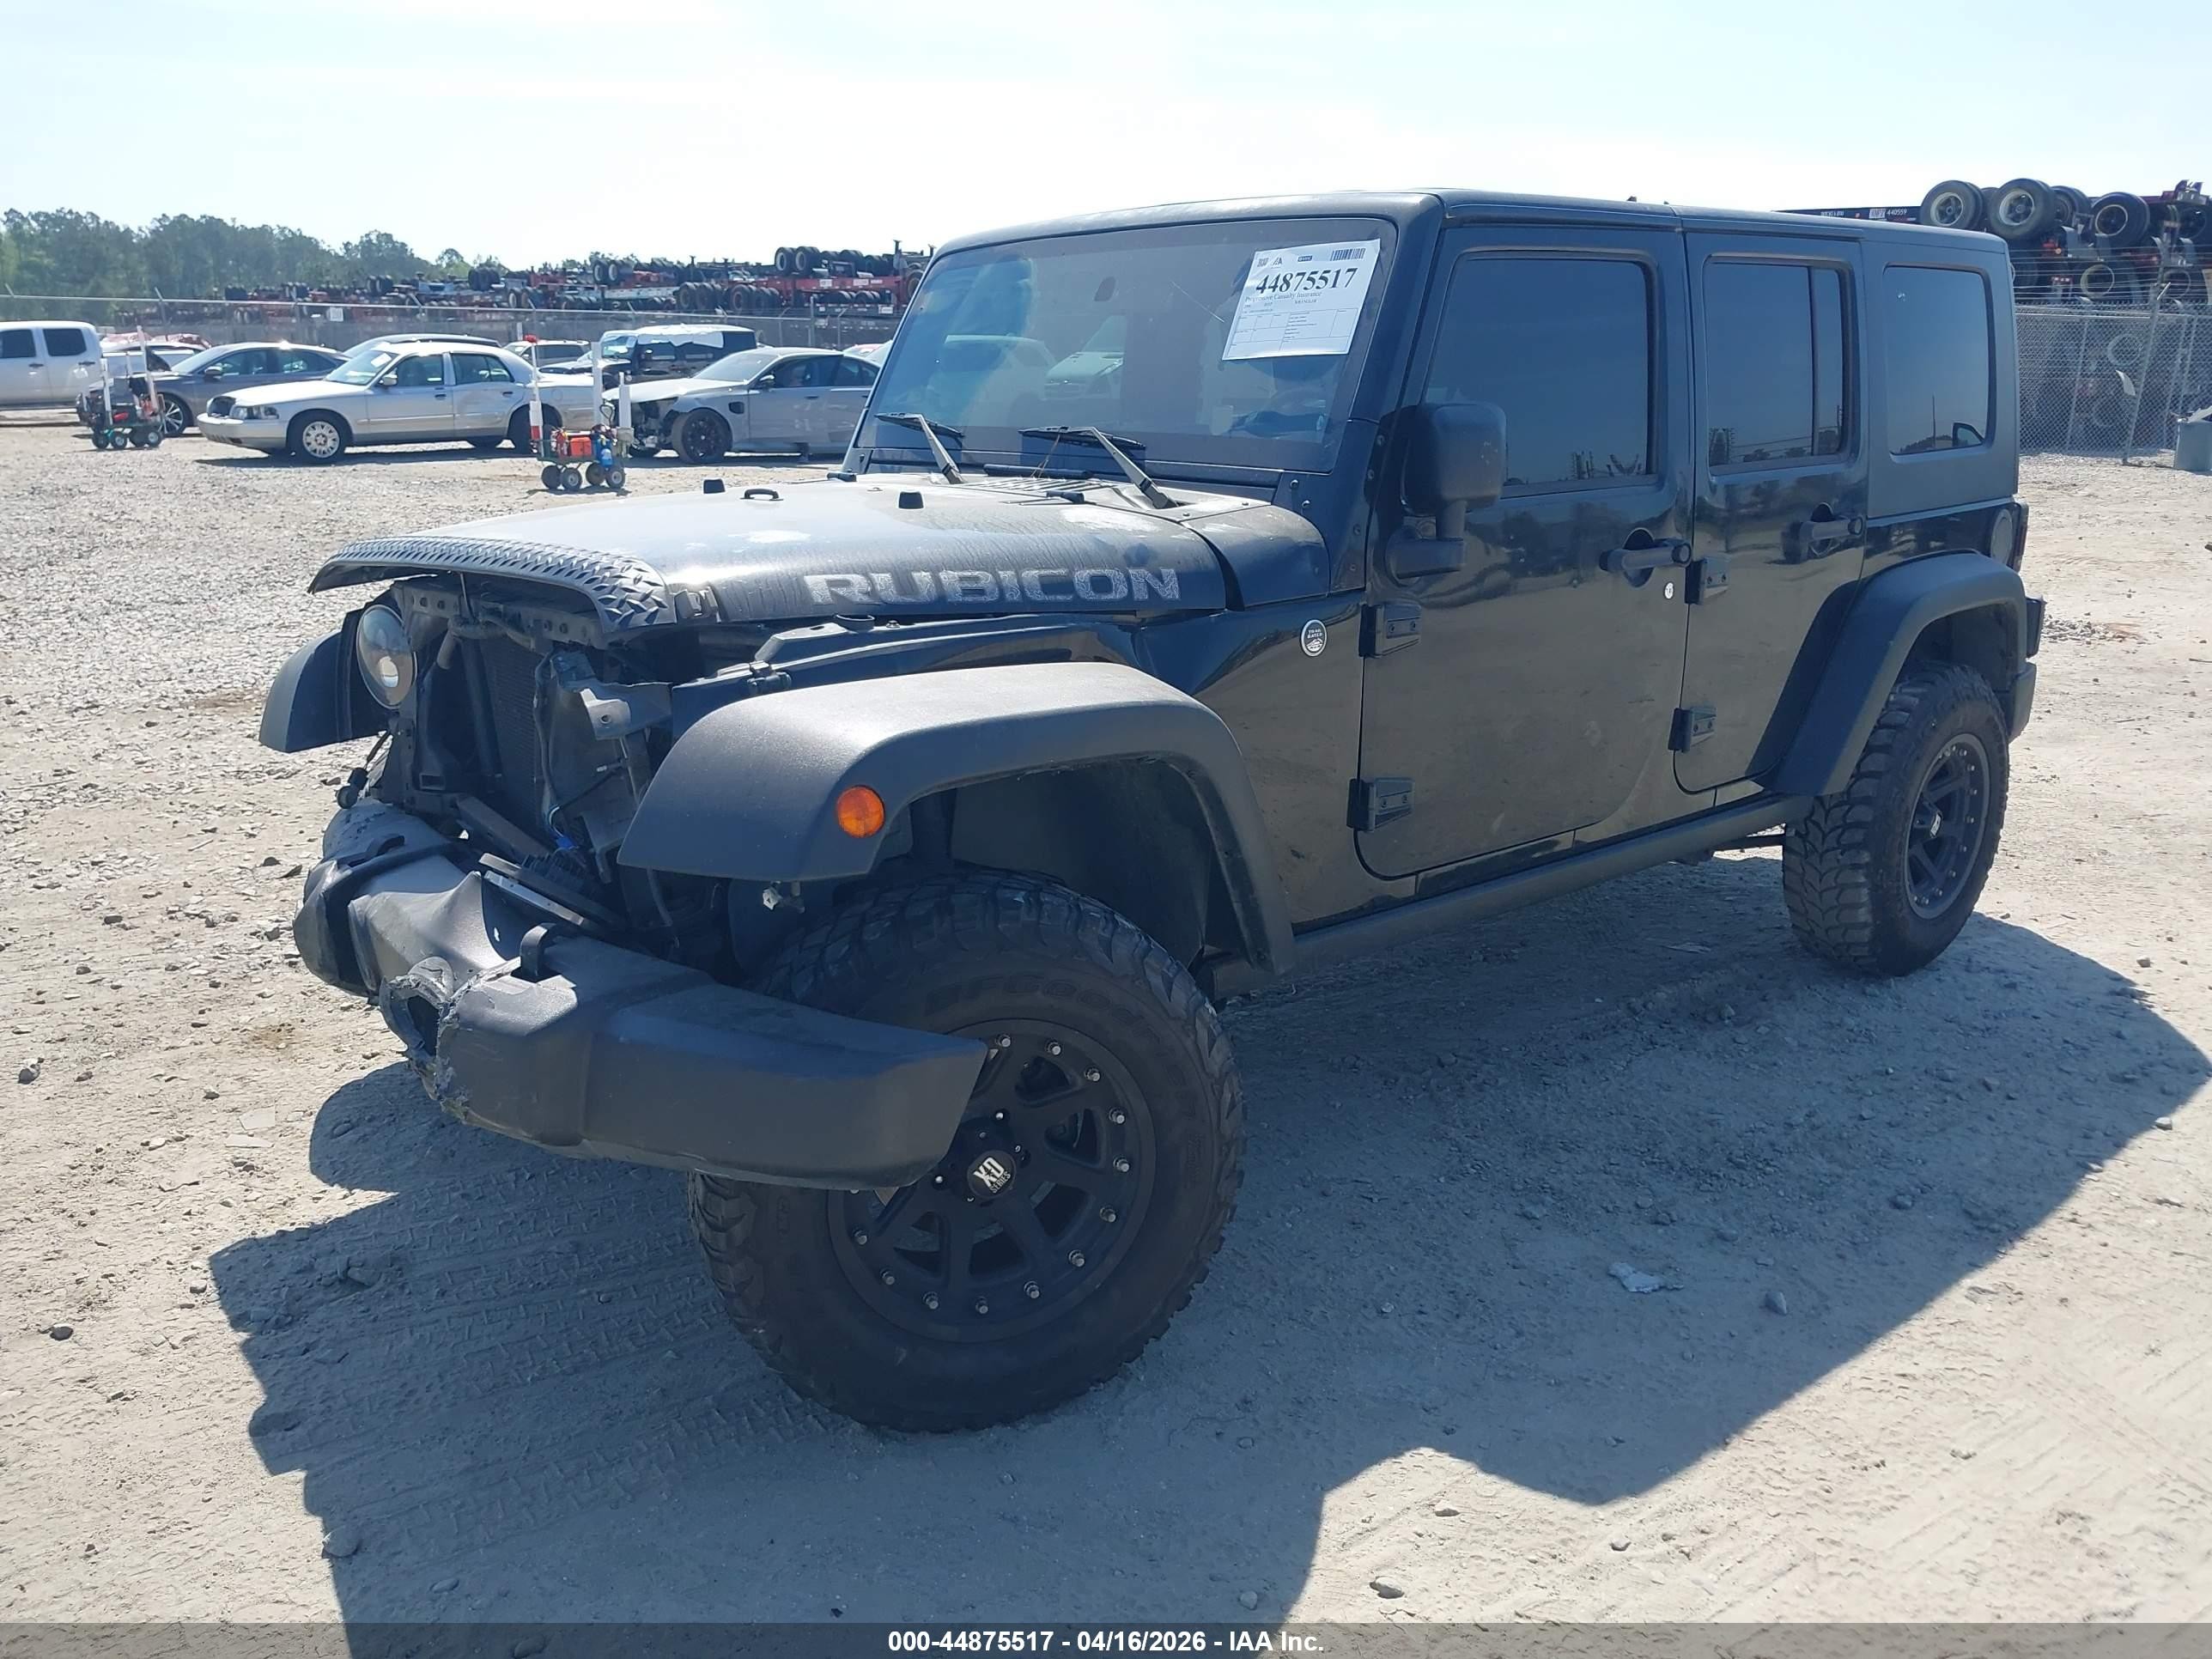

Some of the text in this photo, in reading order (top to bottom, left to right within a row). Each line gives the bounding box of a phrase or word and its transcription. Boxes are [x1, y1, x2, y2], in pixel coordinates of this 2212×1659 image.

[1256, 267, 1358, 294] 44875517
[804, 568, 1182, 602] RUBICON
[989, 1170, 1011, 1194] SERIES
